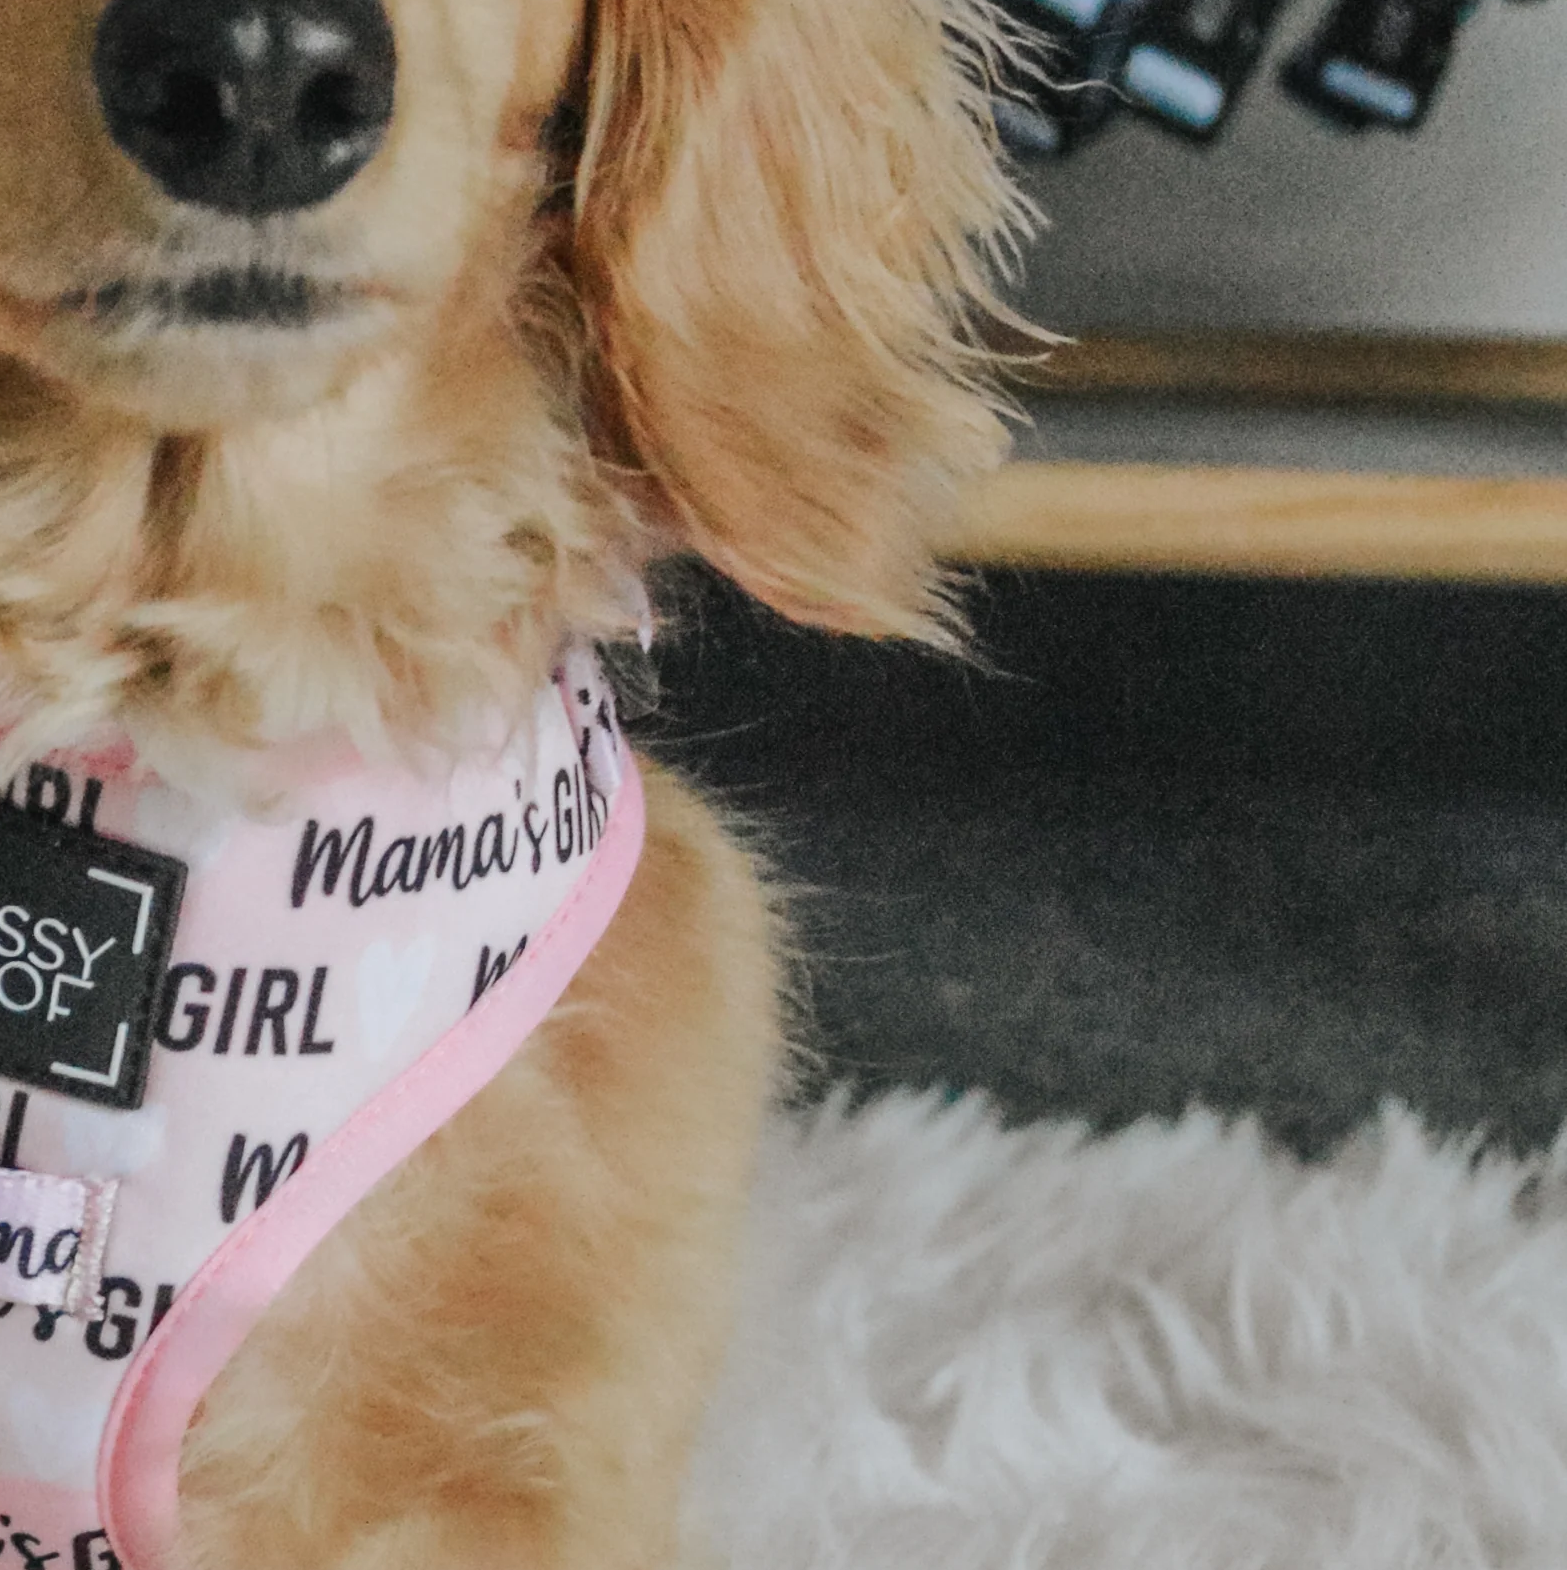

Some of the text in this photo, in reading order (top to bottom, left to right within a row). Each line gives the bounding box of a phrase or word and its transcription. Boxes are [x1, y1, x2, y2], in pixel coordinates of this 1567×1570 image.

[290, 761, 609, 909] Mama's GIR
[152, 962, 335, 1058] GIRL
